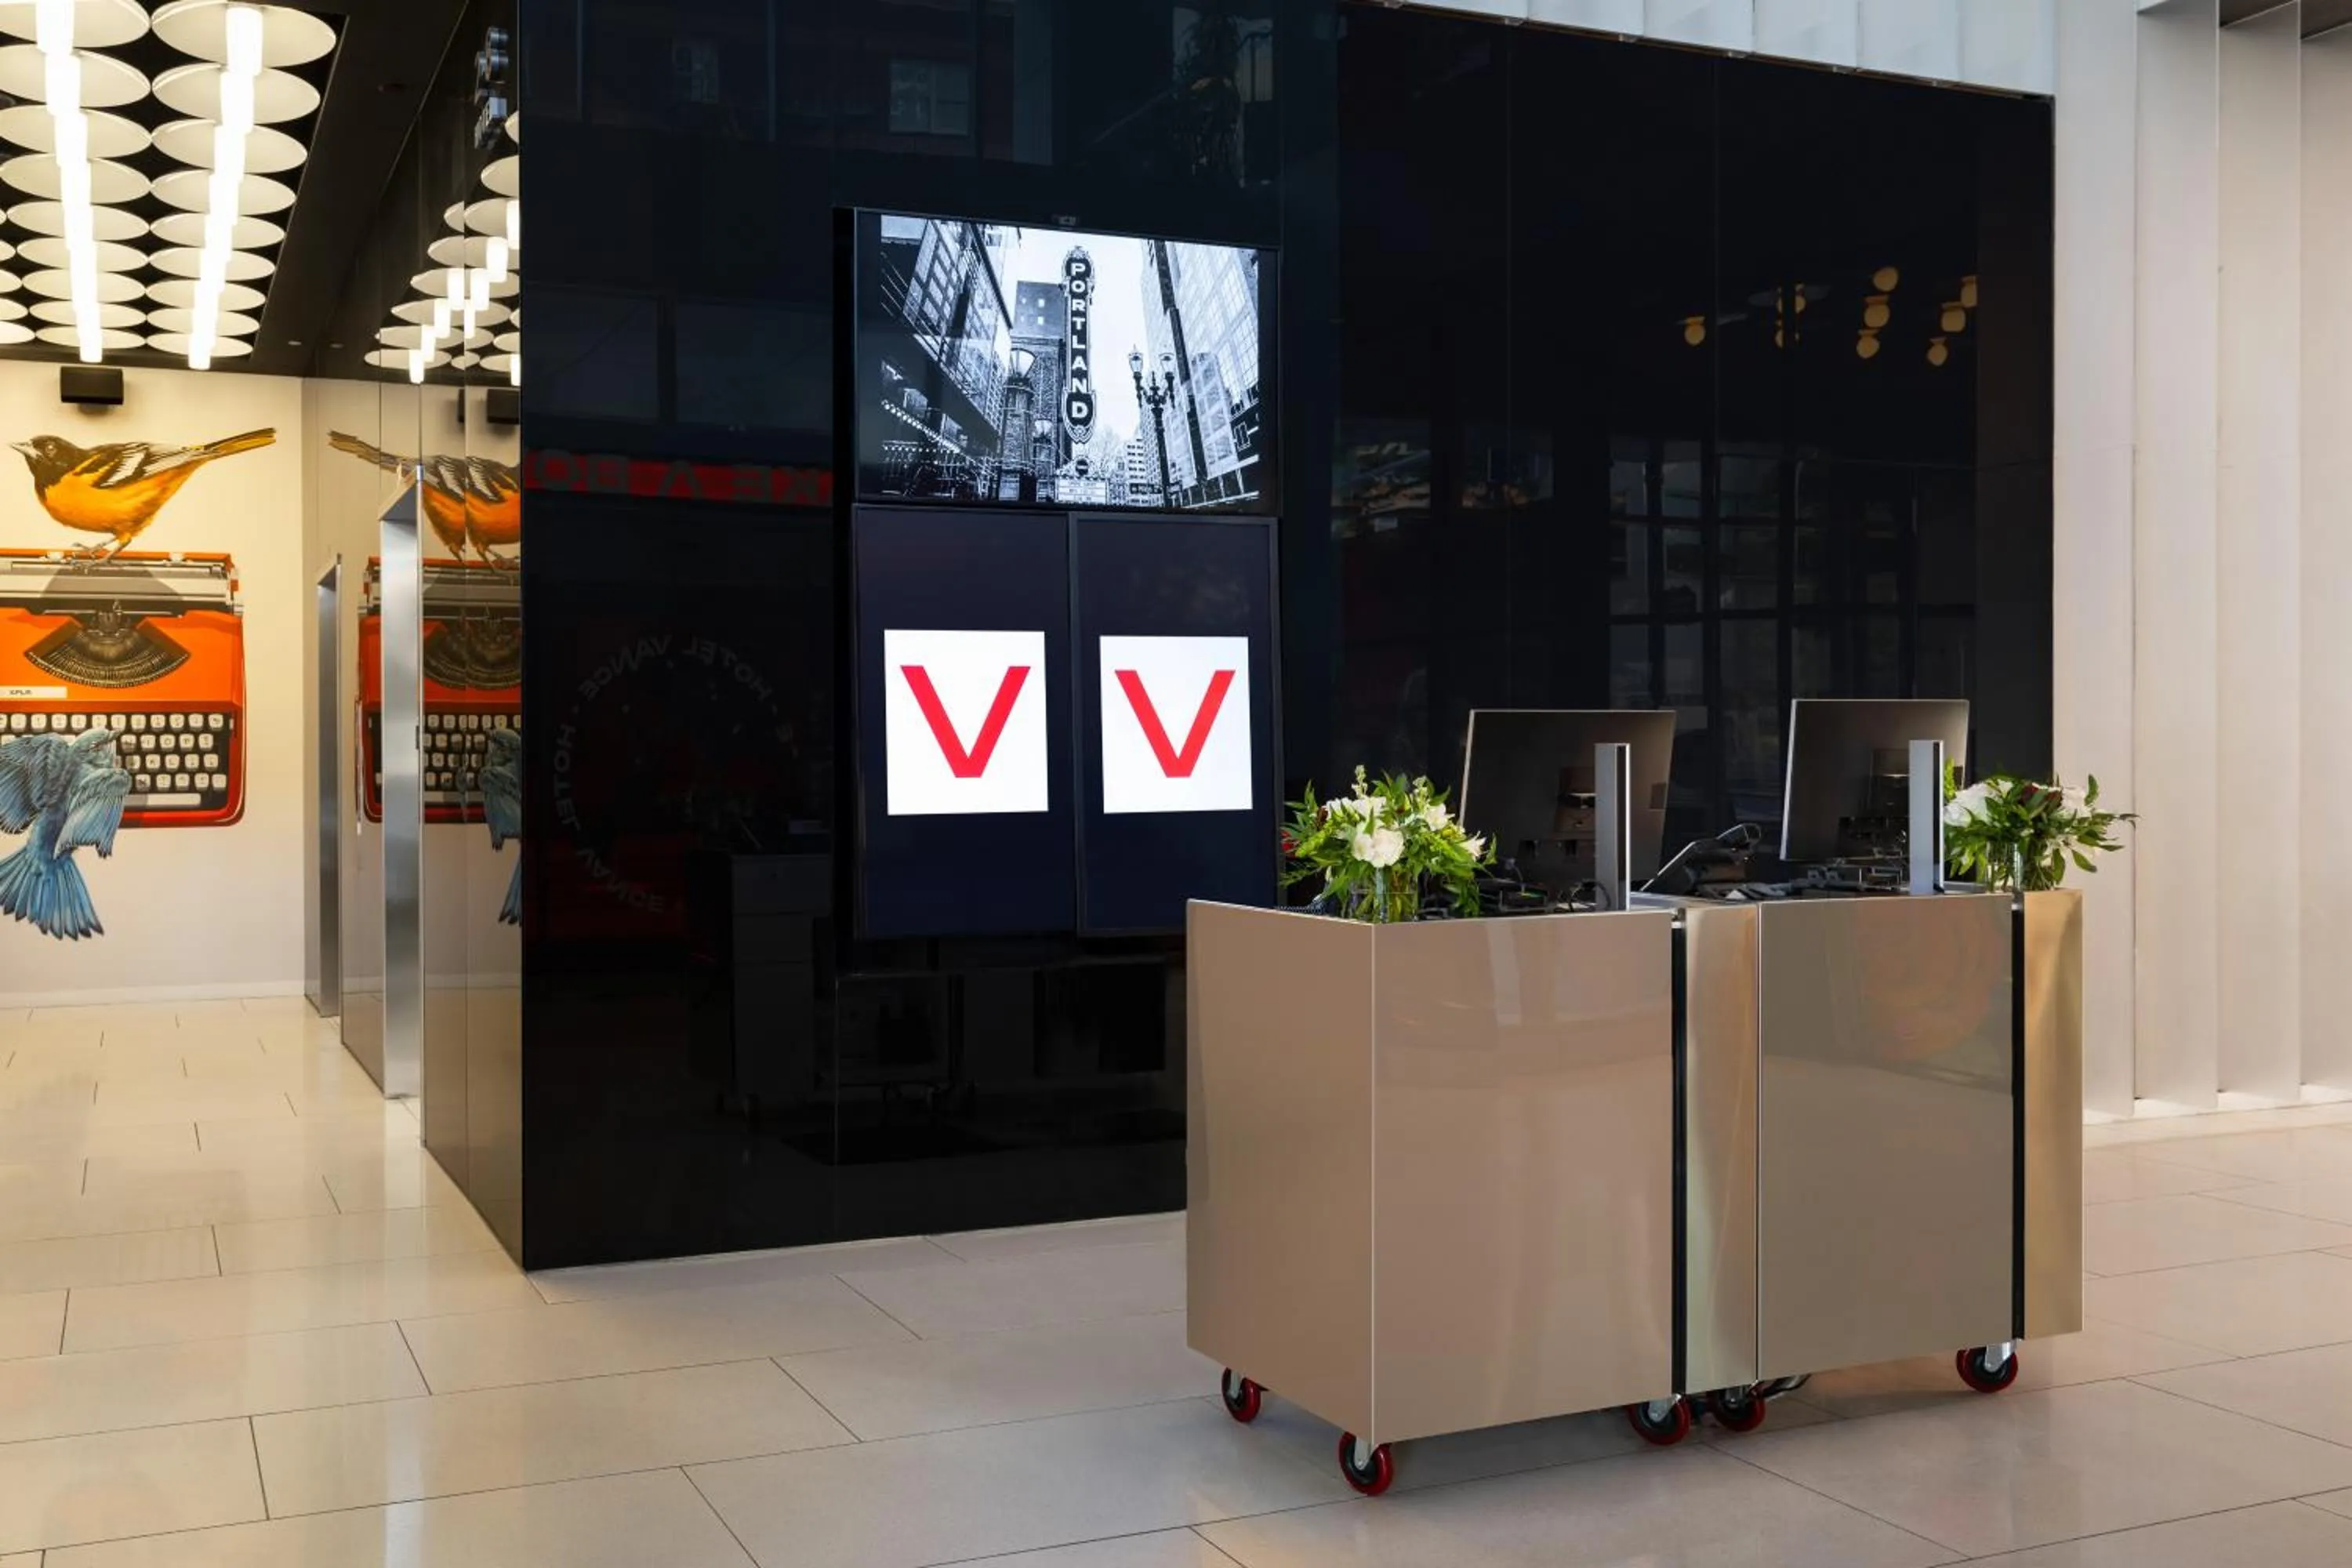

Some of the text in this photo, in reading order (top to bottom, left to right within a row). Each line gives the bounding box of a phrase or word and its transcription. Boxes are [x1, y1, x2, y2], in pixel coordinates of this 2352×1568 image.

[1070, 261, 1089, 419] PORTLAND
[900, 665, 1031, 778] V
[1115, 670, 1236, 778] V
